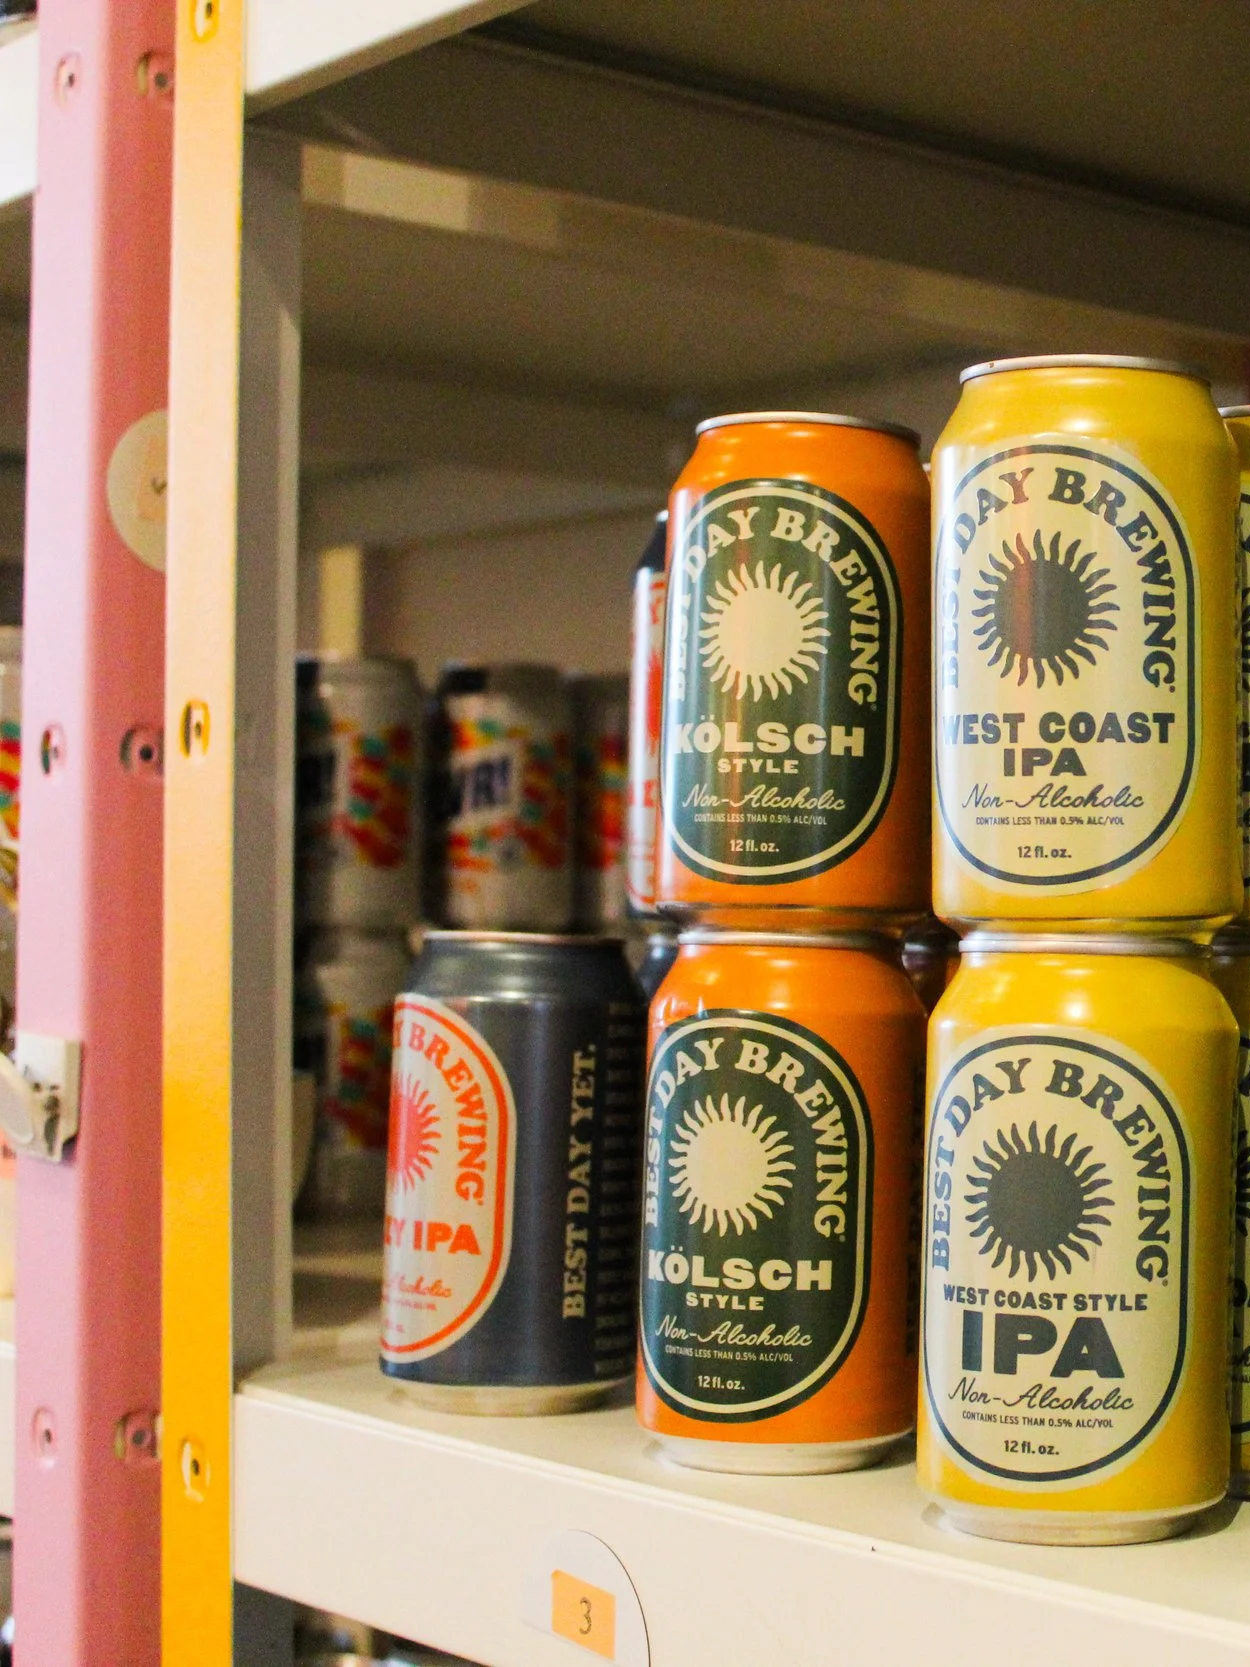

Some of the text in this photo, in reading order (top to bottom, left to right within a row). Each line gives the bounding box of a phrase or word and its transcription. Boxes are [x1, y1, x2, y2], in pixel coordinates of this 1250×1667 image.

[950, 466, 1035, 555] DAY
[1048, 466, 1177, 688] BREWING
[684, 506, 761, 583] DAY
[769, 506, 880, 707] BREWING
[673, 715, 865, 757] KÖLSCH
[942, 711, 1176, 745] WEST COAST
[717, 758, 799, 774] STYLE
[1003, 747, 1088, 777] IPA
[682, 783, 846, 811] Non-Alcoholic
[961, 783, 1145, 809] Non-Alcoholic
[694, 813, 726, 823] CONTAINS
[726, 813, 745, 823] LESS
[747, 814, 767, 823] THAN
[793, 814, 828, 826] ALC/VOL
[975, 816, 1010, 826] CONTAINS
[1012, 816, 1032, 826] LESS
[1033, 816, 1057, 826] THAN
[1086, 816, 1125, 827] ALC/VOL
[730, 839, 780, 853] 12 fl. oz.
[1017, 846, 1072, 859] 12 fl. oz.
[411, 1022, 488, 1202] BREWING
[944, 1057, 1032, 1139] DAY
[643, 1036, 848, 1241] BEST DAY BREWING
[562, 1043, 597, 1321] BEST DAY YET.
[1045, 1059, 1170, 1284] BREWING
[932, 1135, 957, 1272] BEST
[413, 1220, 481, 1256] IPA
[647, 1245, 833, 1291] KÖLSCH
[686, 1291, 764, 1311] STYLE
[943, 1283, 1148, 1311] WEST COAST STYLE
[655, 1314, 813, 1347] Non-Alcoholic
[961, 1309, 1126, 1379] IPA
[665, 1344, 794, 1363] CONTAINS LESS THAN 0.5% ALC/VOL
[697, 1375, 745, 1390] 12 fl. oz.
[948, 1376, 1135, 1411] Non-Alcoholic
[962, 1410, 1114, 1429] CONTAINS LESS THAN 0.5% ALC/VOL
[1004, 1440, 1060, 1456] 12 fl. oz.
[579, 1596, 592, 1635] 3
